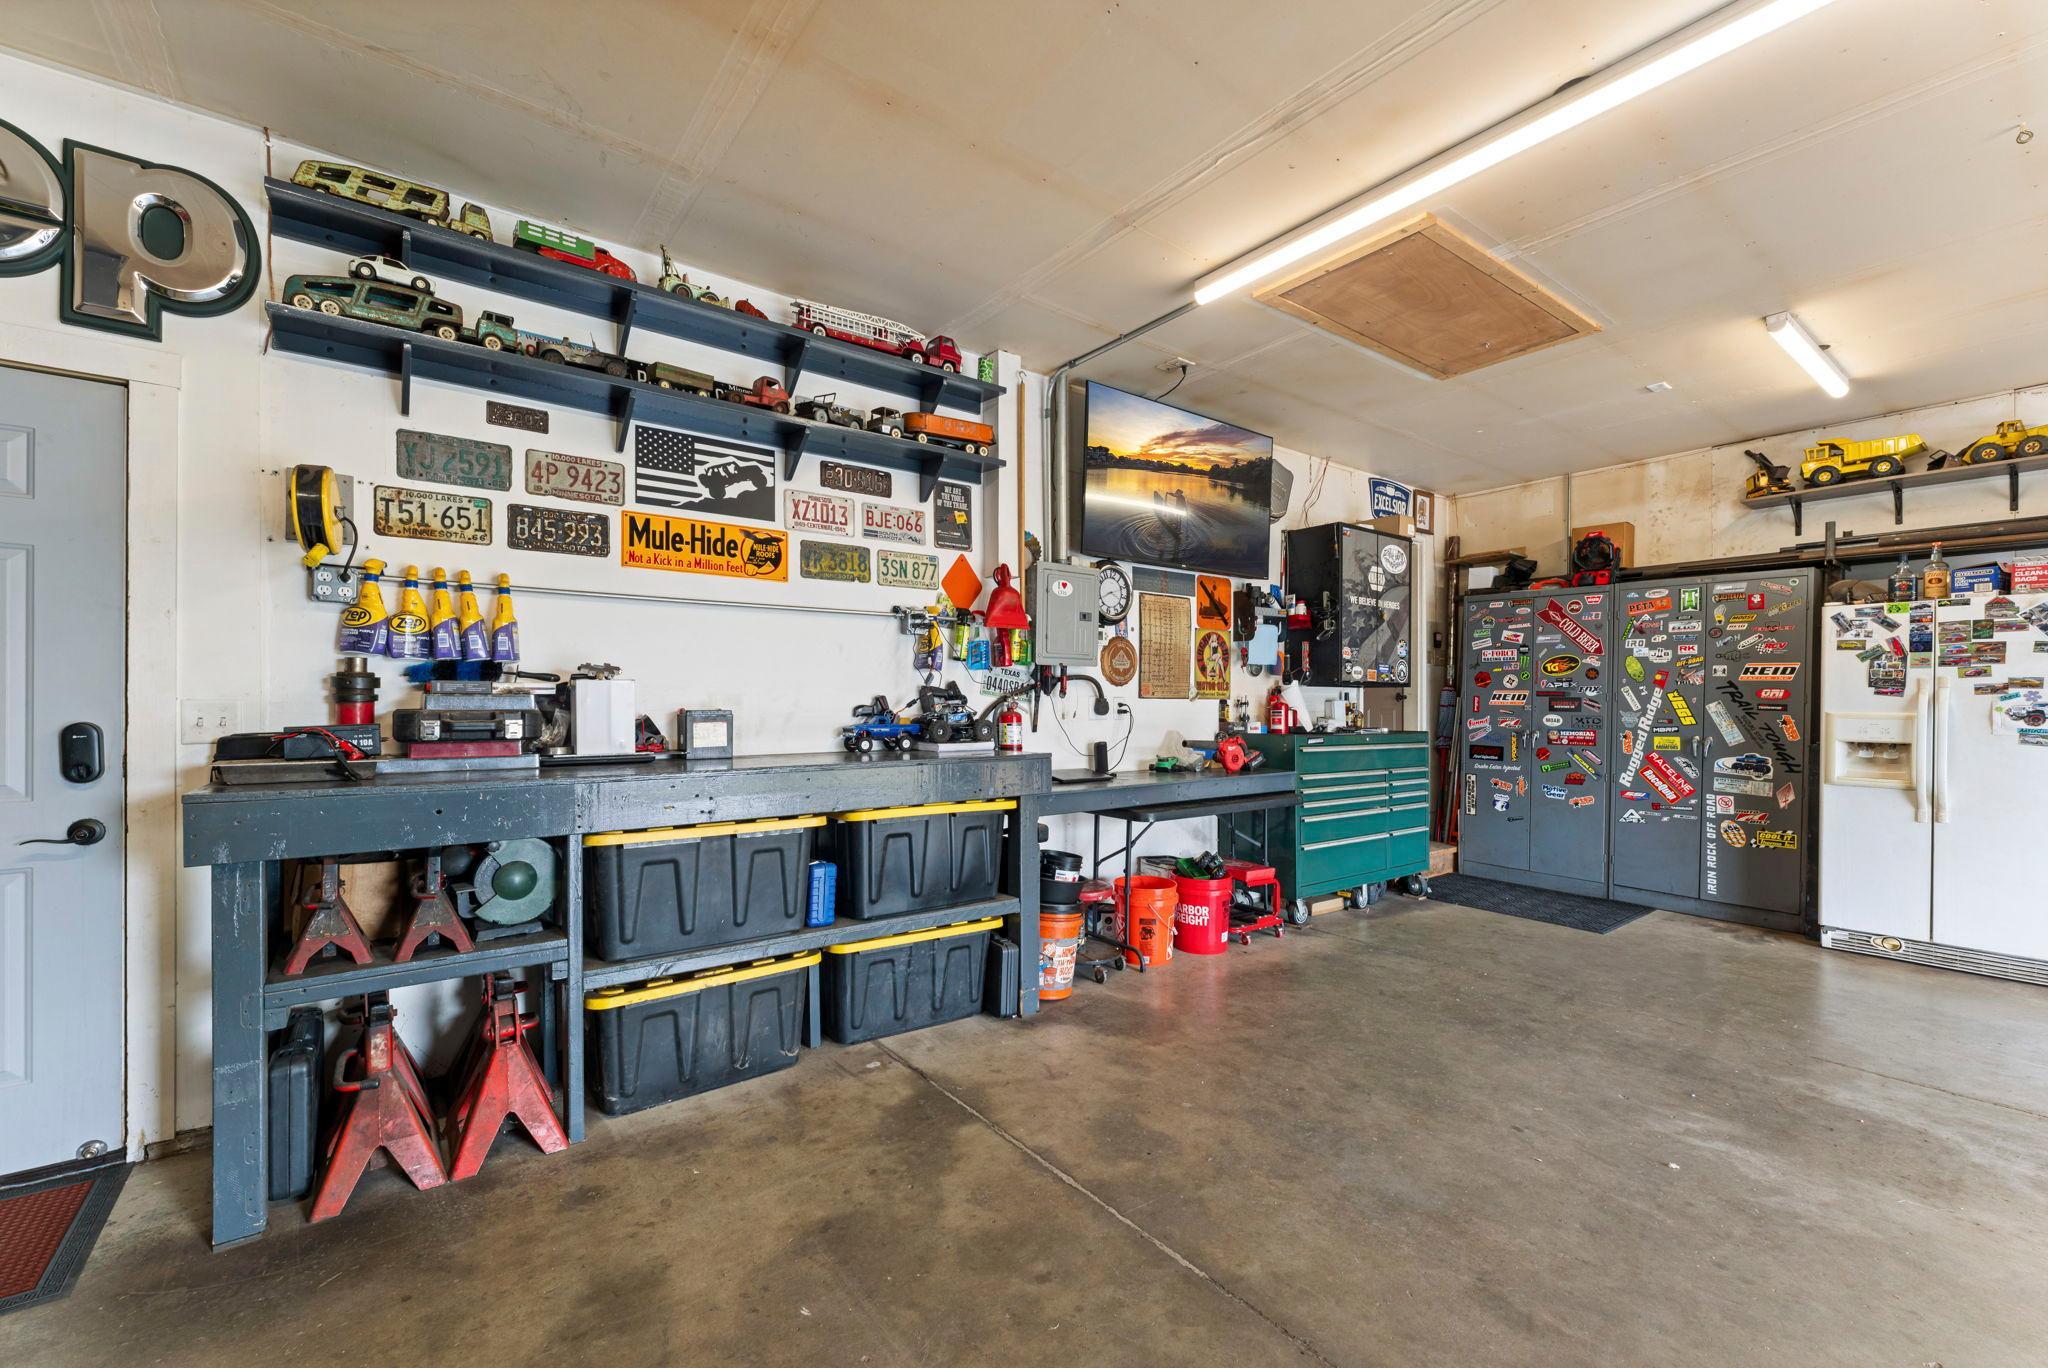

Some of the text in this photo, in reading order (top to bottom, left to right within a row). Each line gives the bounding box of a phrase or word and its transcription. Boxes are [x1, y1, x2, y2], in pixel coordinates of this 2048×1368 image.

[531, 460, 622, 496] 4P 9423
[435, 494, 464, 504] LAKES
[551, 488, 603, 502] MINNESOTA
[1374, 493, 1406, 516] EXCELSIOR
[401, 527, 467, 541] MINNESOTA
[628, 515, 739, 558] Mule-Hide
[753, 543, 780, 553] MULE-HIDE
[646, 556, 652, 565] a
[653, 552, 672, 567] Kick
[675, 556, 684, 568] in
[687, 559, 692, 569] a
[694, 557, 724, 572] Million
[756, 551, 776, 560] ROOFS
[880, 557, 937, 582] 3SN 877
[892, 578, 927, 588] MINNESOTA
[1349, 595, 1358, 605] WE
[1358, 596, 1377, 607] BELIEVE
[1383, 600, 1400, 610] HEROES
[1629, 601, 1655, 612] PETA
[1560, 617, 1600, 653] COLD BEER
[1483, 649, 1516, 657] G-FORCE
[1676, 656, 1704, 668] OFF-ROAD
[1001, 667, 1021, 678] TEXAS
[1742, 666, 1797, 676] REID
[1491, 693, 1528, 701] REID
[1715, 679, 1760, 720] TRAIL
[1759, 722, 1802, 774] TOUGH
[1618, 728, 1649, 788] Rugged
[1638, 686, 1664, 732] Ridge
[1649, 751, 1694, 794] RACELINE
[1542, 784, 1567, 794] Motive
[1546, 790, 1565, 798] Gear
[1759, 831, 1792, 842] COOL IT
[1706, 794, 1717, 895] IRON ROCK OFF ROAD
